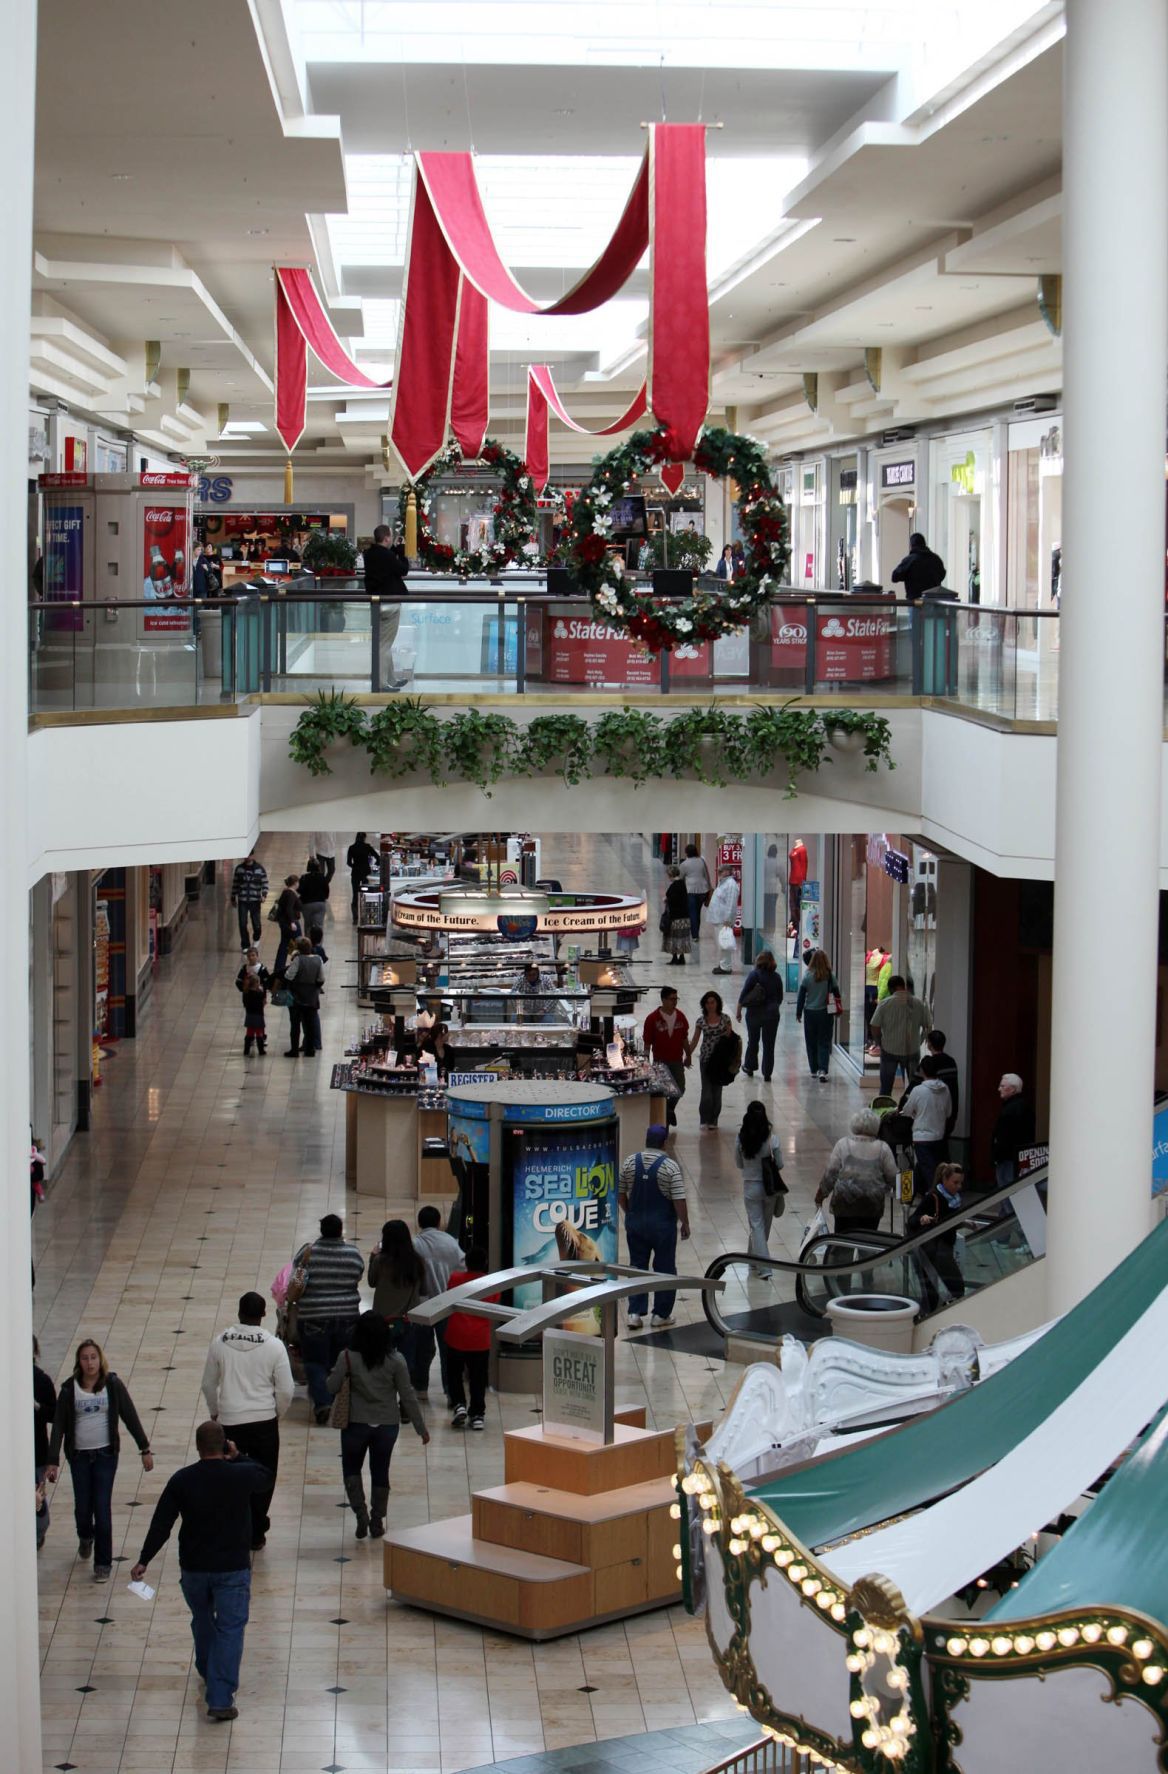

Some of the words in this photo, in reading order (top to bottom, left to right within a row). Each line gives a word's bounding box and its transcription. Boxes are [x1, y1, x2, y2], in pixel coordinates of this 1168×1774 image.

[63, 519, 81, 530] GIFT
[783, 627, 803, 638] 90
[723, 851, 729, 860] 3
[732, 851, 743, 860] FR
[416, 914, 424, 922] of
[427, 913, 440, 923] the
[444, 915, 480, 925] Future.
[544, 917, 559, 926] Ice
[563, 916, 595, 926] Cream
[597, 915, 607, 924] of
[609, 913, 622, 923] the
[545, 1105, 601, 1119] DIRECTORY
[525, 1164, 572, 1173] HELMERICH
[553, 1356, 597, 1384] GREAT
